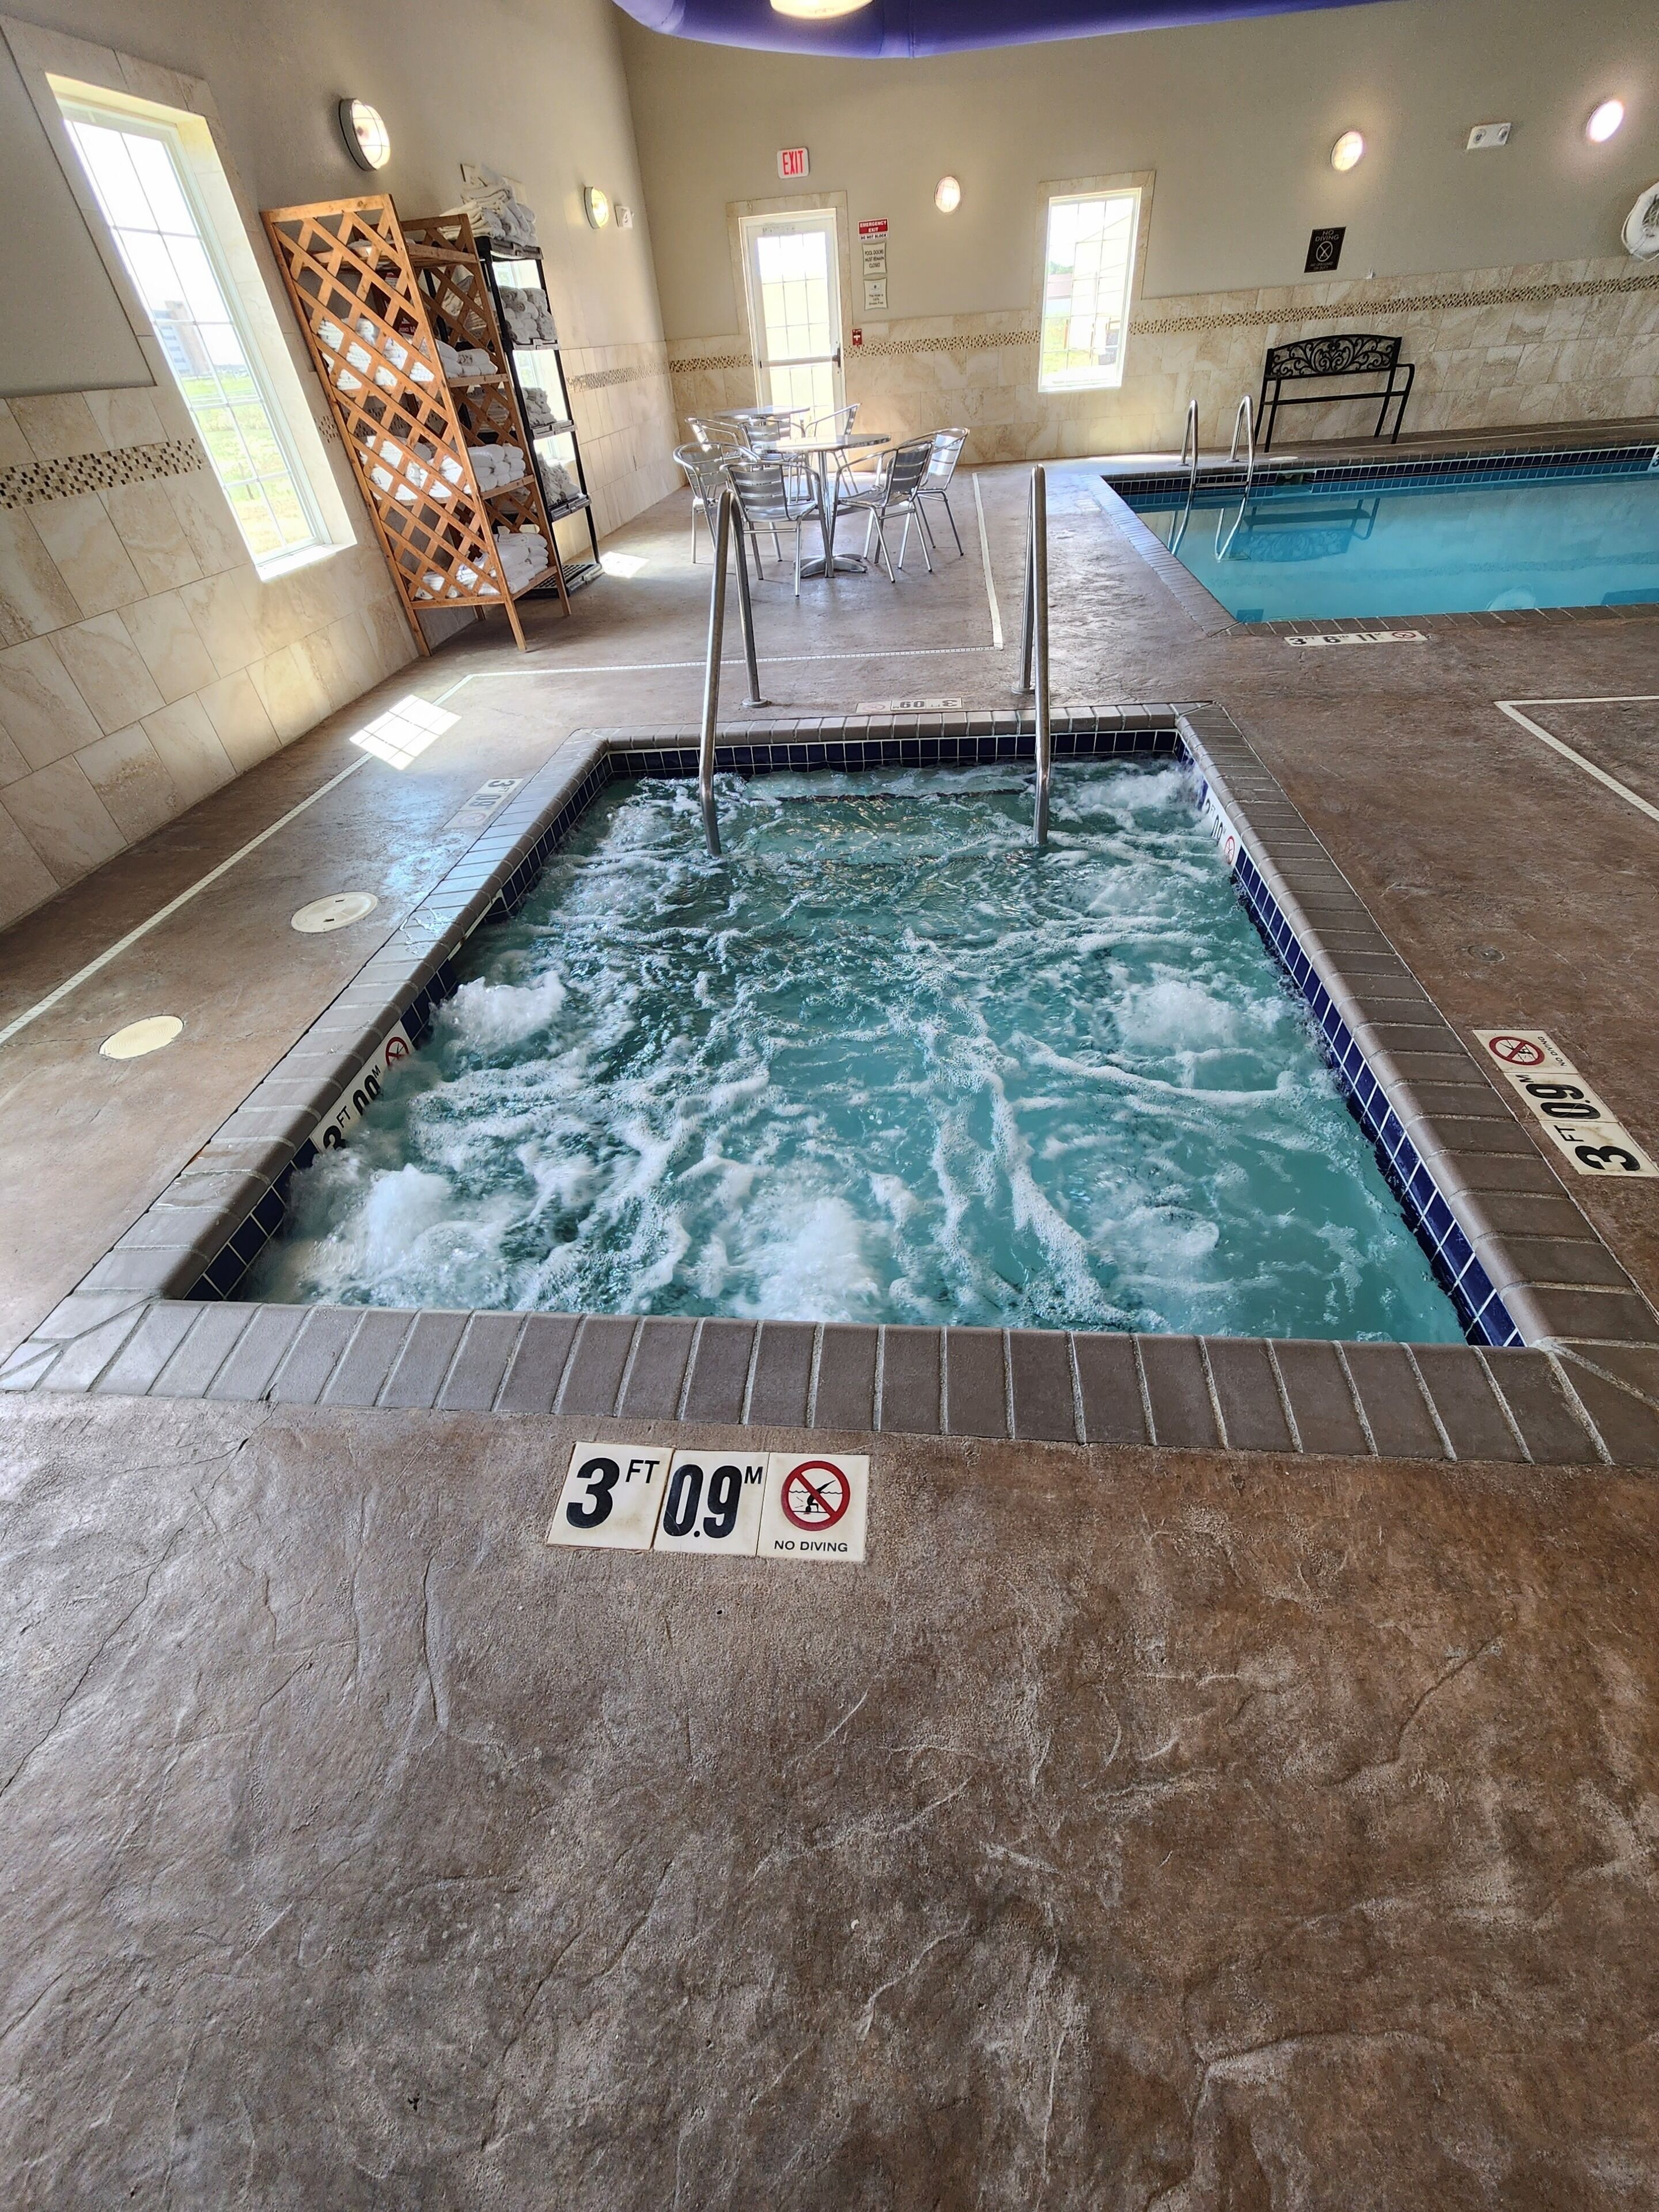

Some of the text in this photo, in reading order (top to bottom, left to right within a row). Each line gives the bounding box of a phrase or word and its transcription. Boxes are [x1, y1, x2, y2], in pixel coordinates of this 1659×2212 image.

[782, 150, 803, 175] EXIT
[1537, 1036, 1567, 1067] NO DIVING
[336, 1106, 351, 1128] FT
[372, 1065, 381, 1079] M
[1516, 1074, 1641, 1172] 3 FT 0.9 M
[566, 1457, 763, 1539] 3 FT 0.9 M
[774, 1540, 849, 1553] NO DIVING
